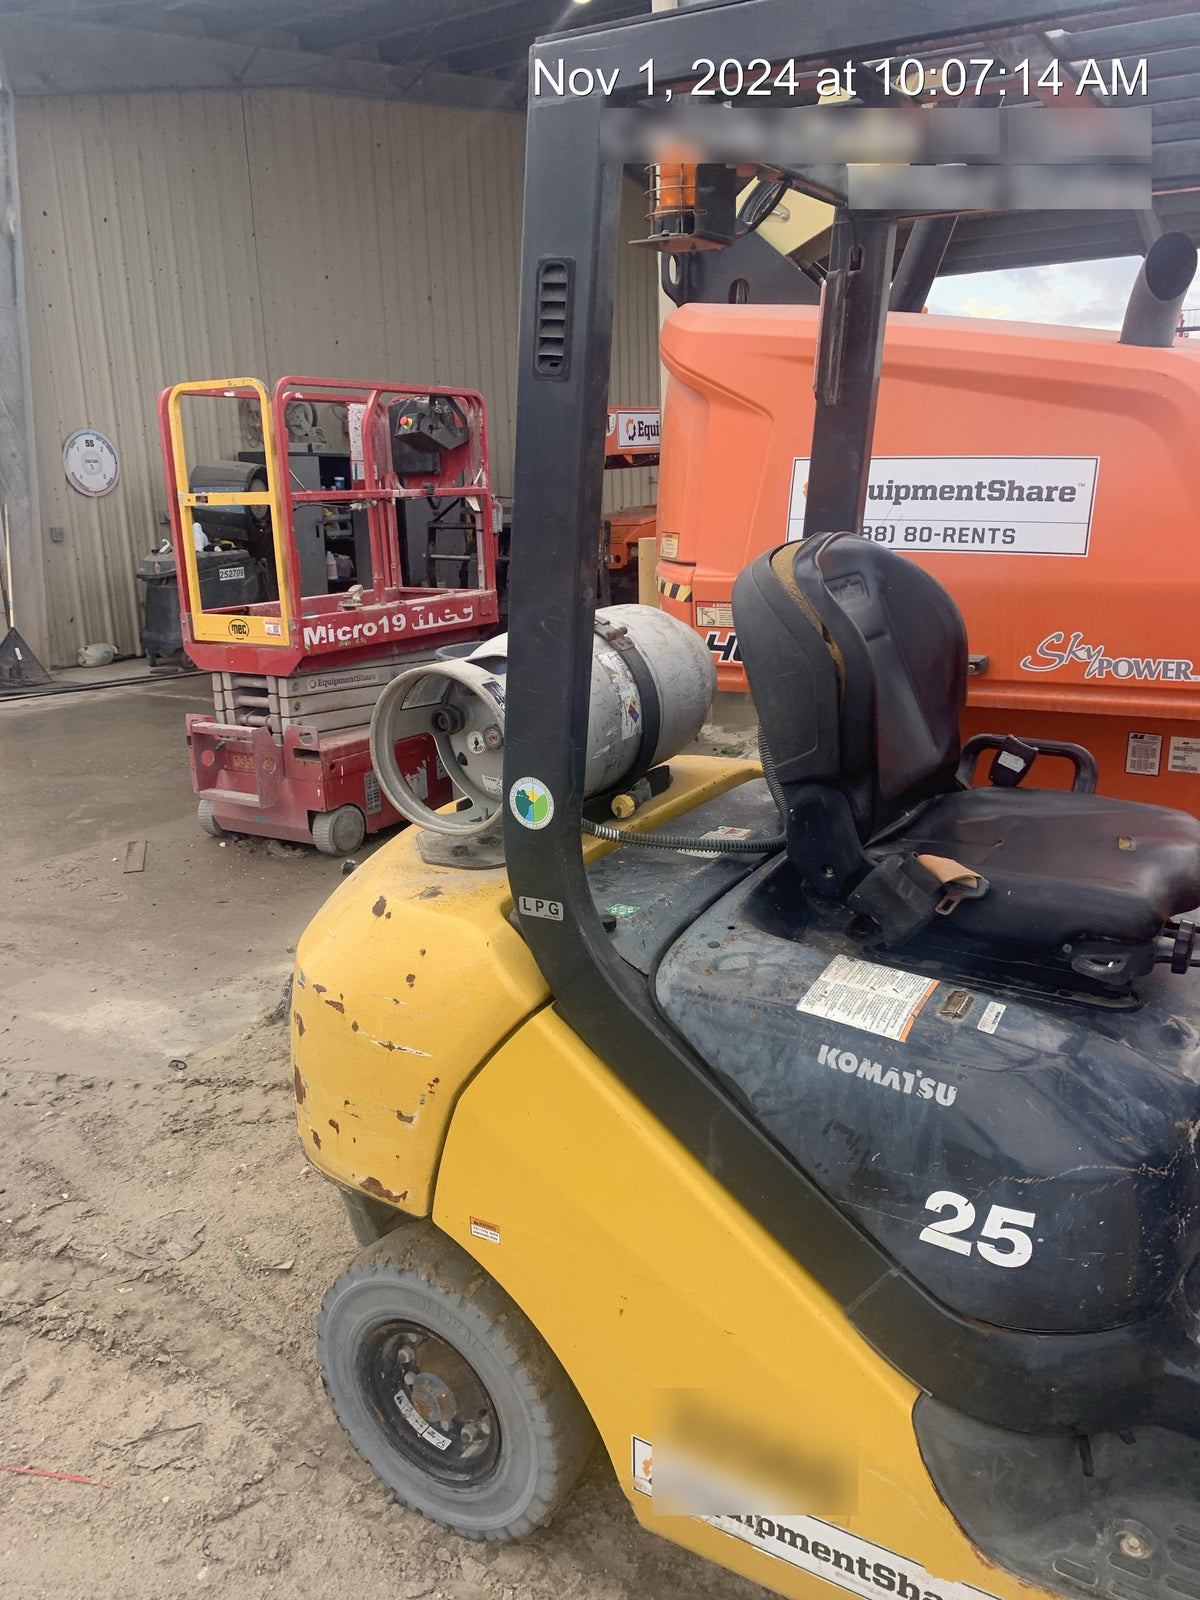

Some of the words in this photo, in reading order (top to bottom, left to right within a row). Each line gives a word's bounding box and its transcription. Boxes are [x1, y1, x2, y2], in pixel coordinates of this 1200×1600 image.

[637, 420, 660, 441] Equi
[868, 479, 1077, 506] uipmentShare
[862, 525, 896, 544] 88)
[904, 526, 1017, 545] 80-RENTS
[303, 613, 407, 646] Micro19
[317, 672, 377, 689] EquipmentShare
[817, 1044, 958, 1107] KOMATSU
[918, 1190, 1036, 1268] 25
